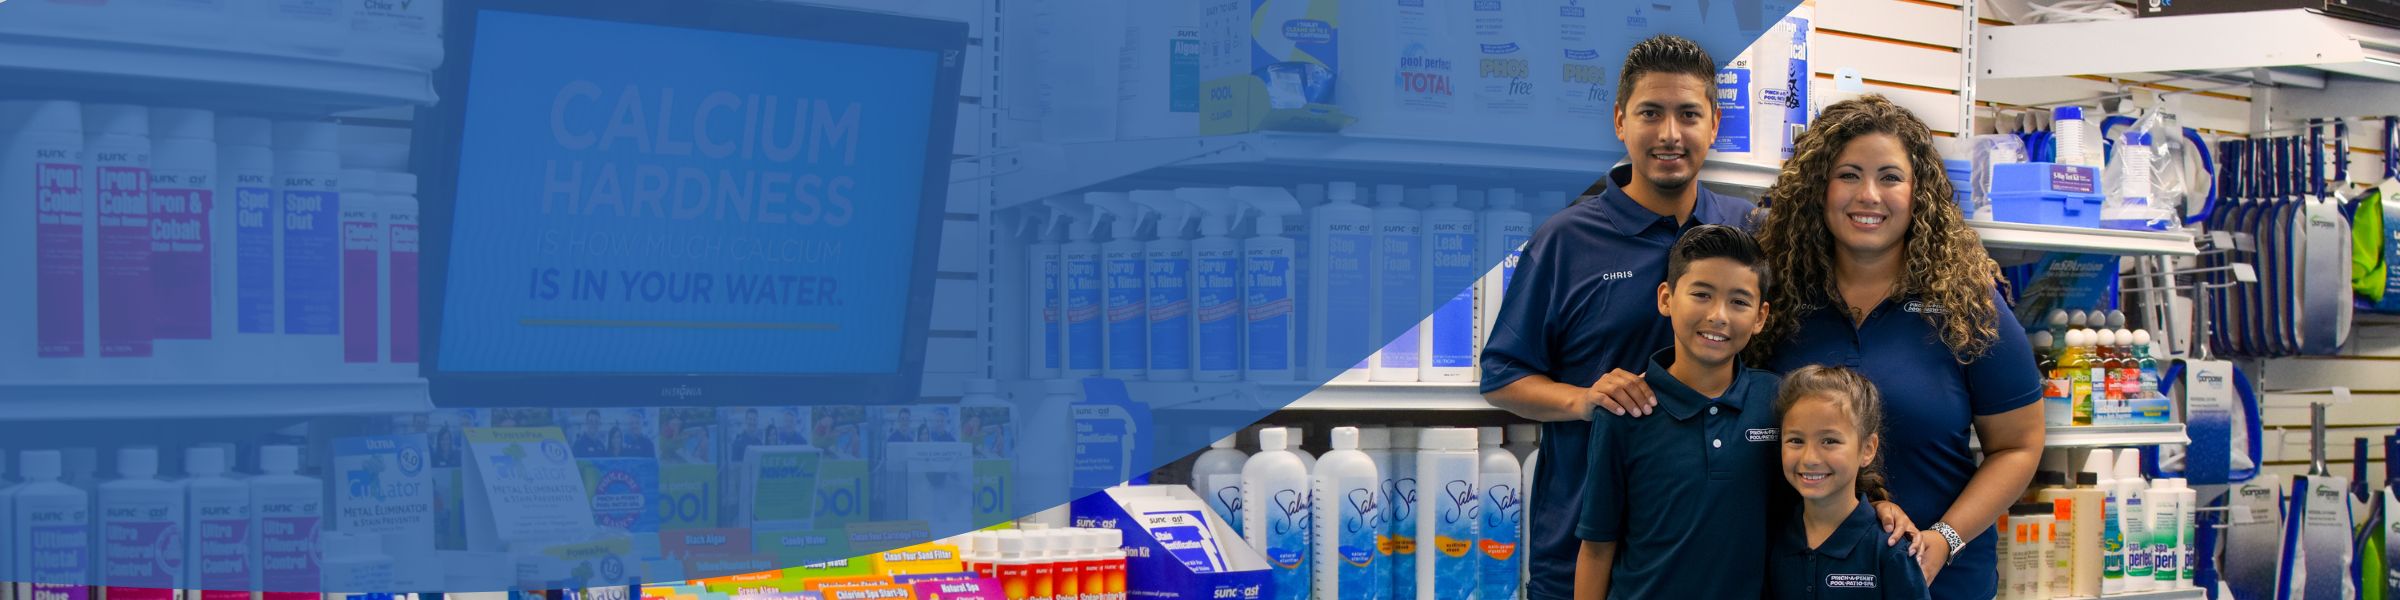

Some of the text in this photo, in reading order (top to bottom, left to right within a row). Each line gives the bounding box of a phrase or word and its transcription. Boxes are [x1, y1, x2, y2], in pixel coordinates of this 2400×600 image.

[1400, 56, 1423, 68] pool
[1480, 58, 1530, 78] PHOS
[1400, 71, 1453, 96] TOTAL
[1509, 77, 1535, 97] free
[1587, 82, 1609, 102] free
[550, 79, 863, 167] CALCIUM
[39, 165, 75, 188] Iron
[99, 166, 137, 191] Iron
[238, 190, 270, 210] Spot
[540, 159, 857, 227] HARDNESS
[151, 191, 202, 214] Iron &
[286, 193, 323, 214] Spot
[238, 208, 264, 228] Out
[286, 212, 314, 231] Out
[151, 217, 202, 241] Cobalt
[535, 229, 842, 265] IS HOW MUCH CALCIUM
[1383, 237, 1409, 257] Stop
[1434, 235, 1463, 251] Leak
[1108, 261, 1136, 275] Spray
[1328, 254, 1359, 273] Foam
[1383, 256, 1411, 273] Foam
[1434, 251, 1472, 268] Sealer
[1068, 262, 1095, 277] Spray
[1603, 270, 1633, 281] CHRIS
[528, 266, 845, 307] IS IN YOUR WATER.
[1157, 275, 1183, 289] Rinse
[1208, 275, 1234, 289] Rinse
[1256, 273, 1283, 287] Rinse
[343, 503, 428, 518] METAL ELIMINATOR
[202, 523, 233, 540] Ultra
[263, 519, 295, 537] Ultra
[1154, 531, 1174, 541] Stain
[706, 535, 727, 546] Algae
[781, 535, 827, 548] Cloudy Water
[2128, 543, 2140, 551] spa
[2154, 543, 2168, 553] spa
[883, 549, 952, 562] Clean Your Sand Filter
[1140, 546, 1151, 558] Kit
[107, 561, 153, 577] Control
[263, 554, 307, 571] Control
[836, 587, 909, 600] Chlorine Spa Start-Up
[940, 583, 980, 594] Natural Spa
